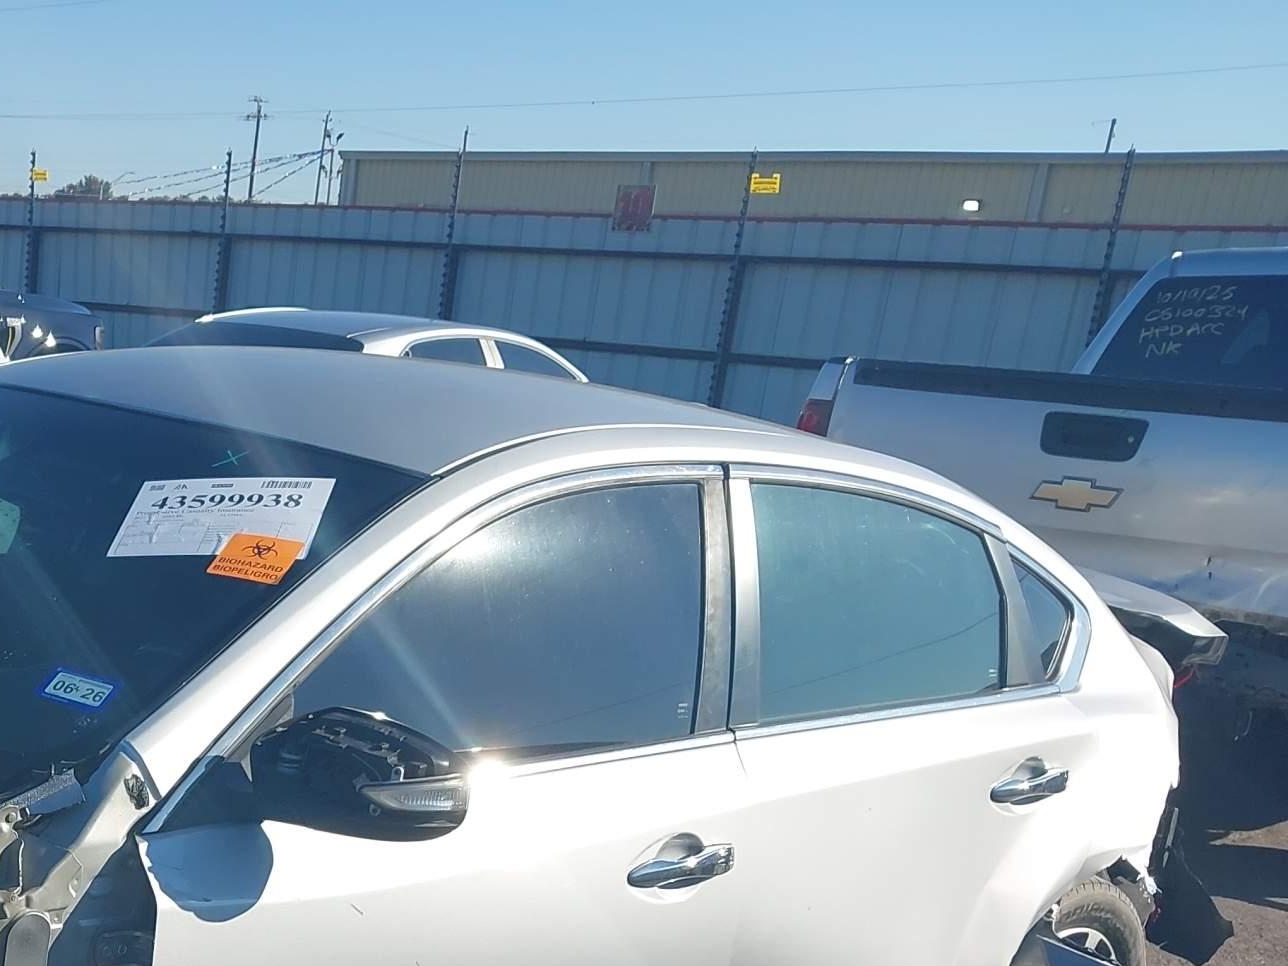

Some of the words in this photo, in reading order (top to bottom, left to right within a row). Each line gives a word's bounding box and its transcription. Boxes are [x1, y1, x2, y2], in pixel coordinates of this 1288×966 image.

[151, 493, 304, 510] 43599938
[212, 564, 279, 581] BIOPELIGRO
[217, 556, 284, 573] BIOHAZARD
[52, 680, 77, 694] 06
[79, 687, 106, 703] 26
